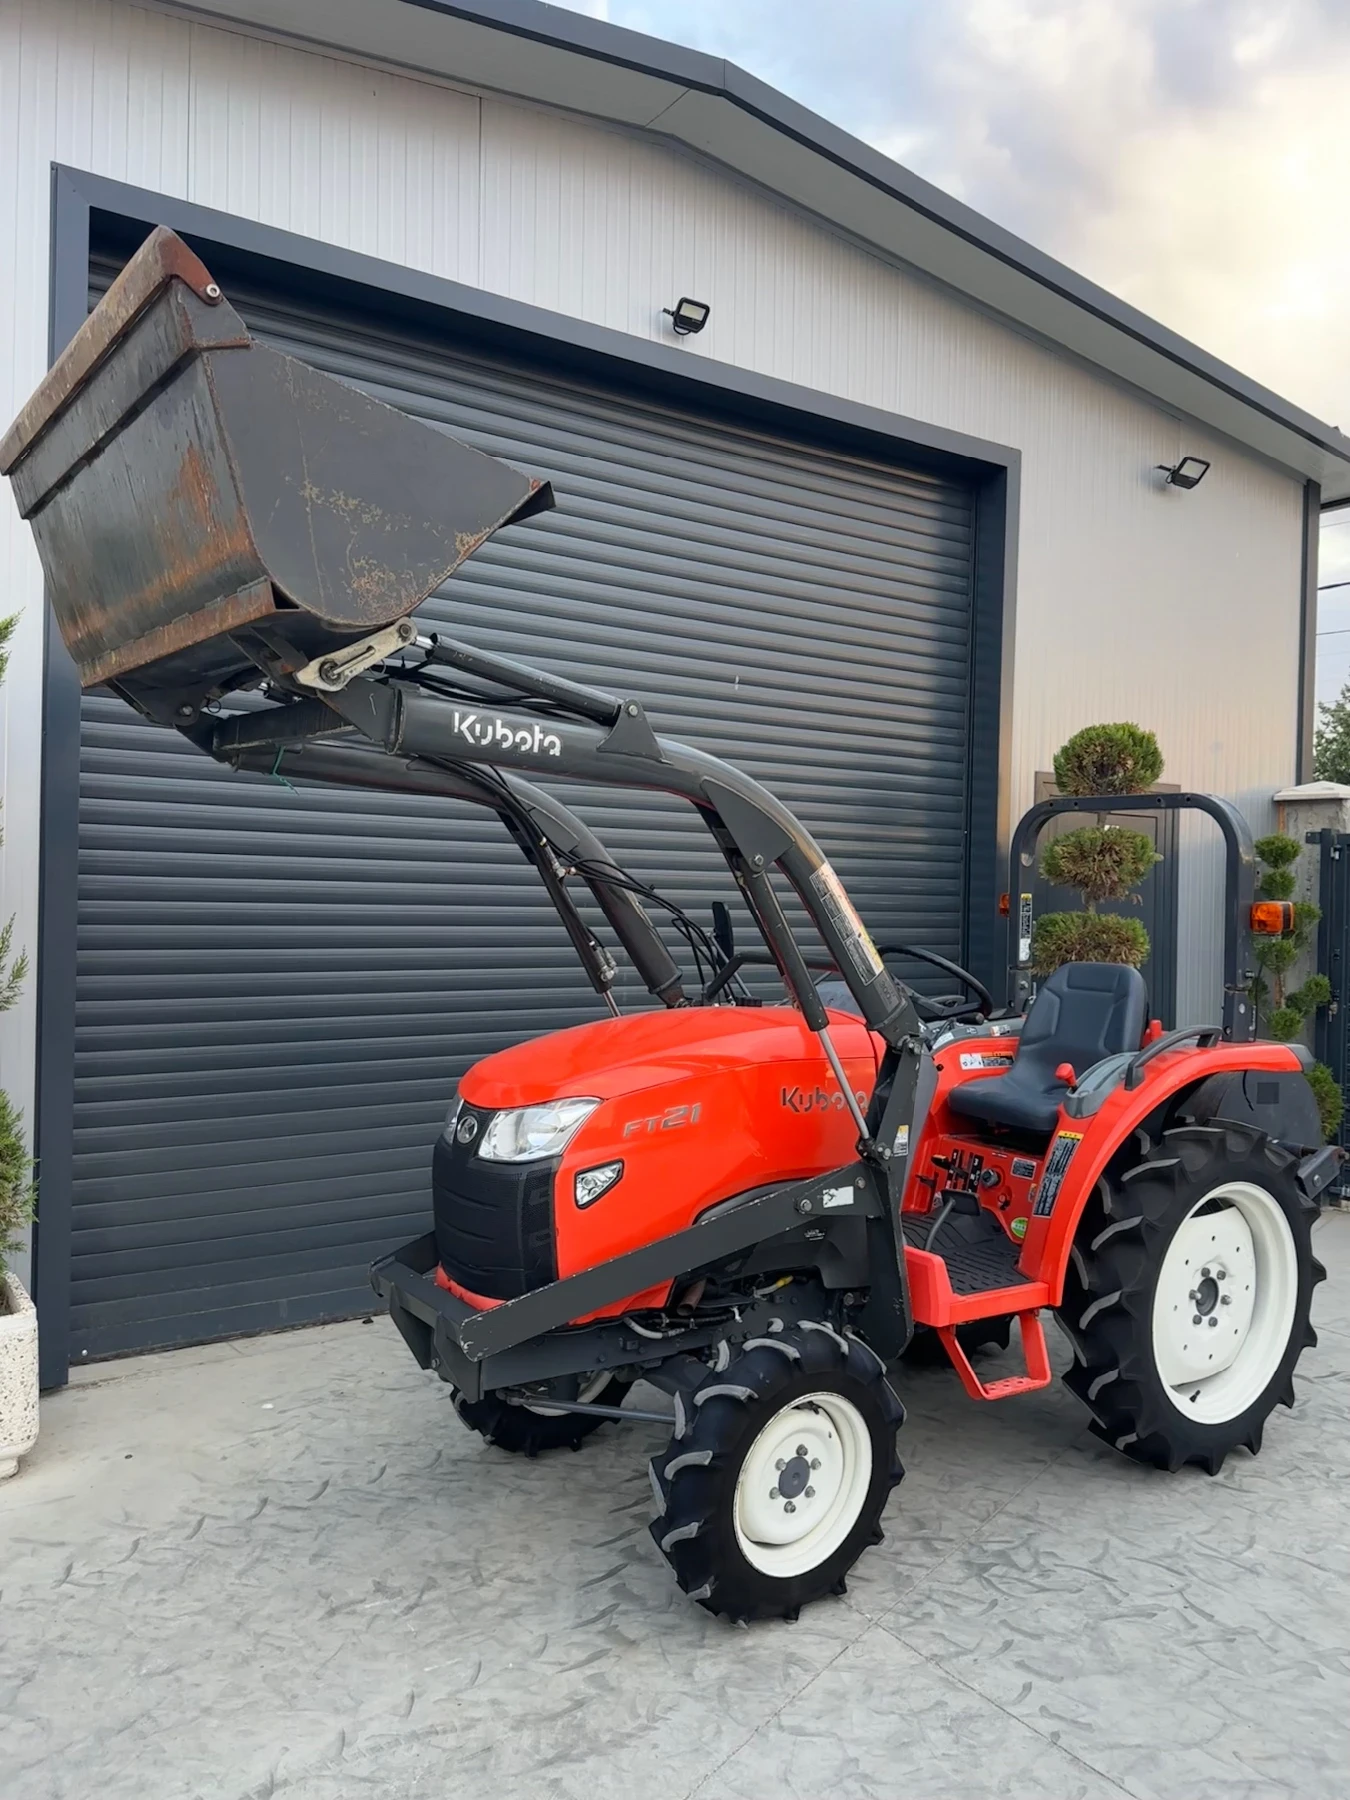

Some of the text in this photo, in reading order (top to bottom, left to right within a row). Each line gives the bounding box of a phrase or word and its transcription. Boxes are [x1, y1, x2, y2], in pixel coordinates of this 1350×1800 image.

[453, 711, 562, 757] Kubota
[782, 1086, 868, 1113] Kuboa
[623, 1102, 701, 1138] FT21
